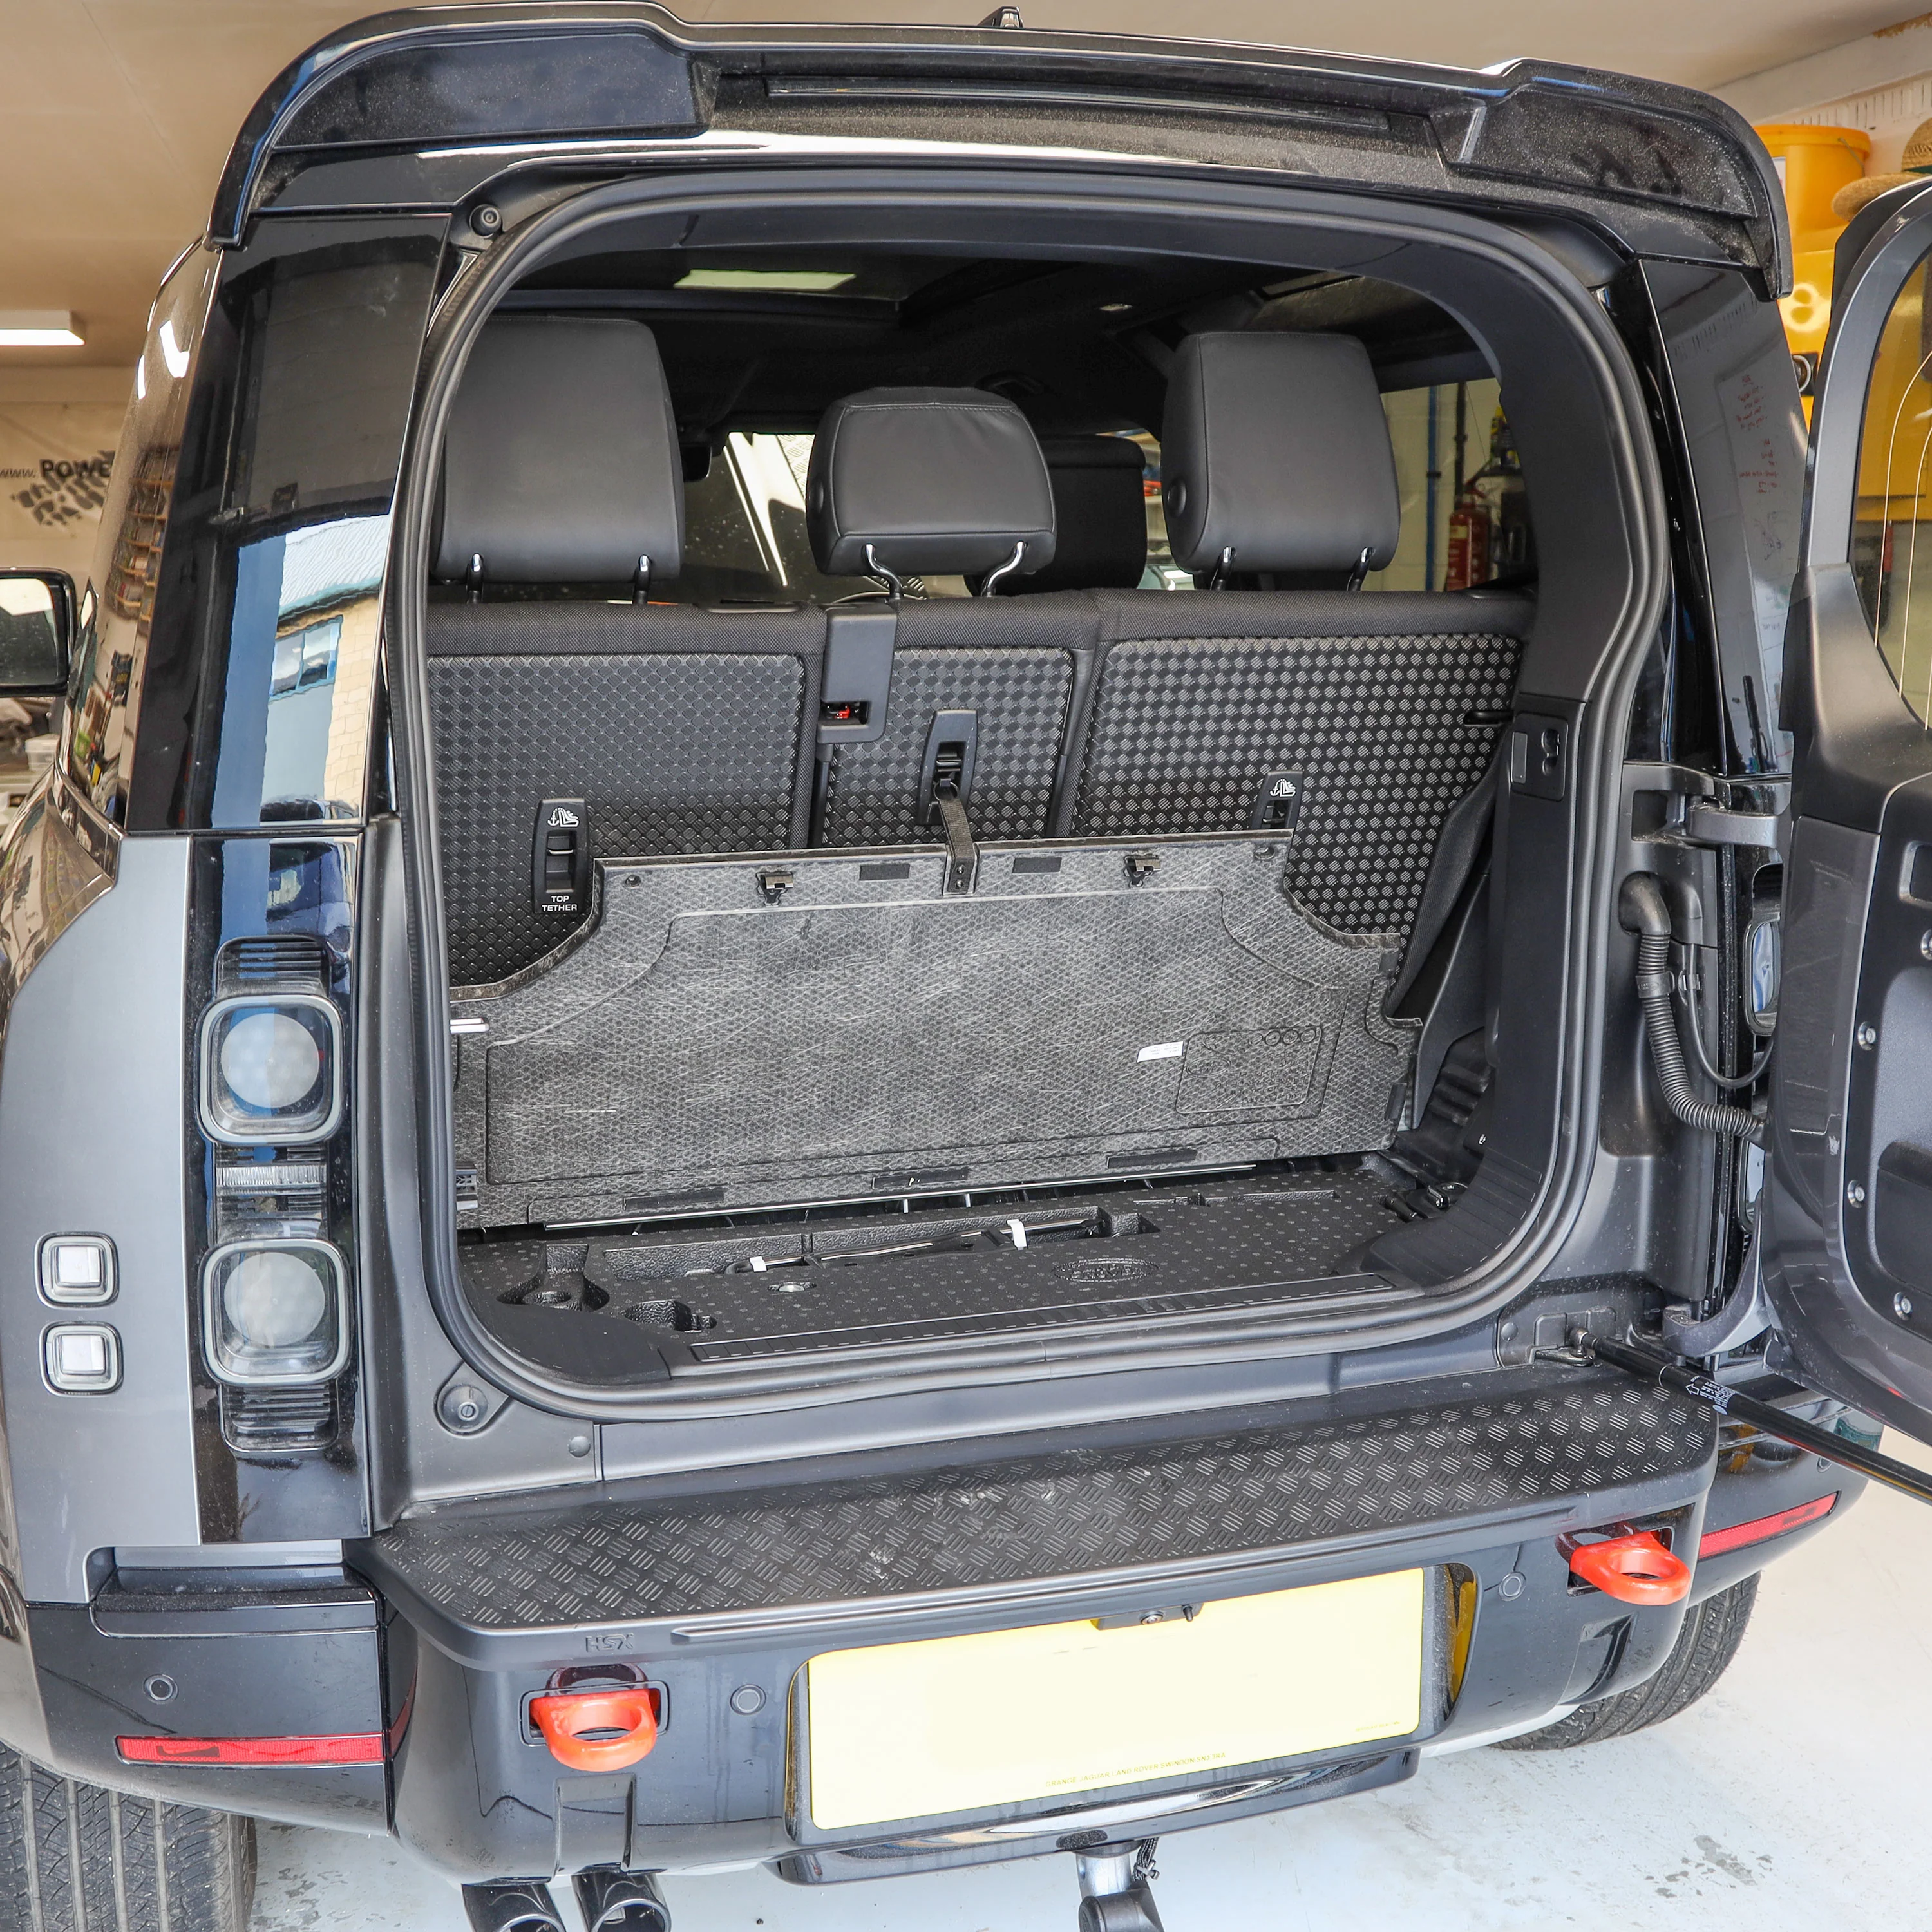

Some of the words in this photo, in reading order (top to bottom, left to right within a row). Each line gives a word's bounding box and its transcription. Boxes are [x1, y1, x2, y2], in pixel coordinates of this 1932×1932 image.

[585, 1633, 634, 1652] HSX
[1045, 1777, 1076, 1787] GRANGE
[1079, 1772, 1110, 1782] JAGUAR
[1112, 1768, 1132, 1777] LAND
[1133, 1763, 1159, 1773] ROVER
[1160, 1758, 1195, 1769] SWINDON
